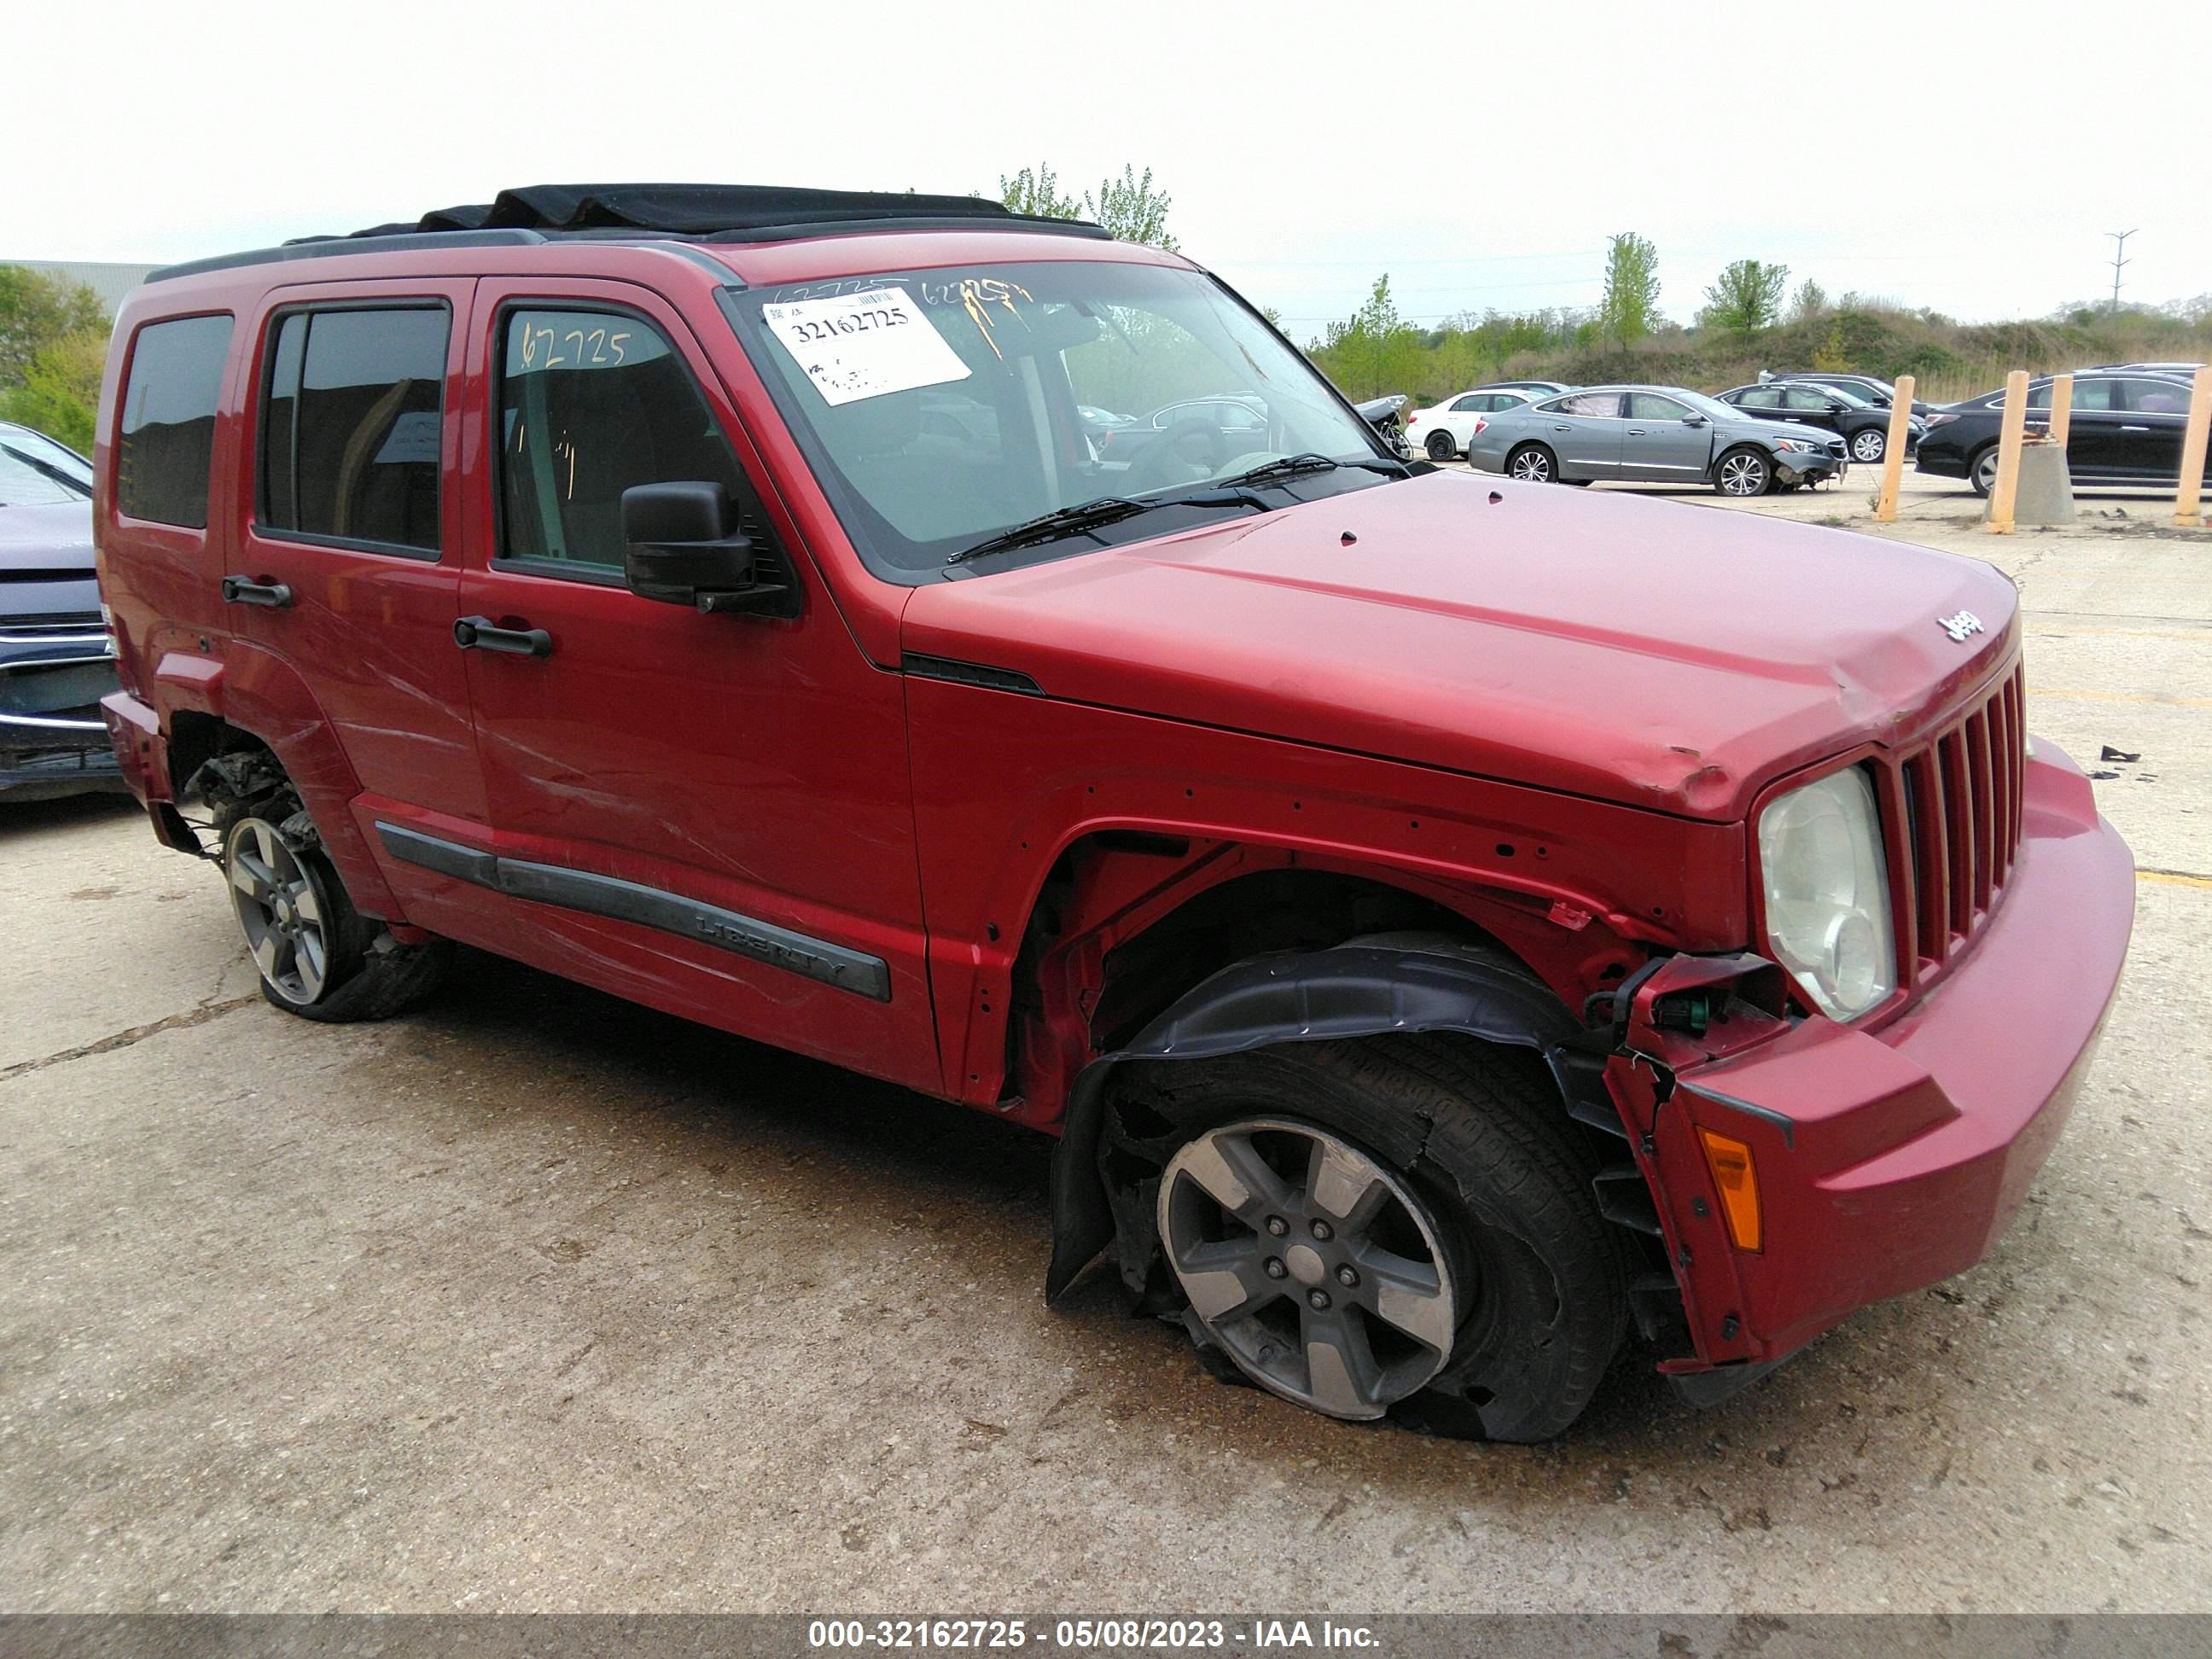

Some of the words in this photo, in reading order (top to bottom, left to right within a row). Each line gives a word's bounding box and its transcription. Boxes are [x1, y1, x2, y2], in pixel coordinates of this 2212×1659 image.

[791, 308, 909, 342] 32162725
[521, 322, 631, 369] 62725
[1938, 610, 1985, 642] Jeep
[696, 917, 846, 974] LIBERTY
